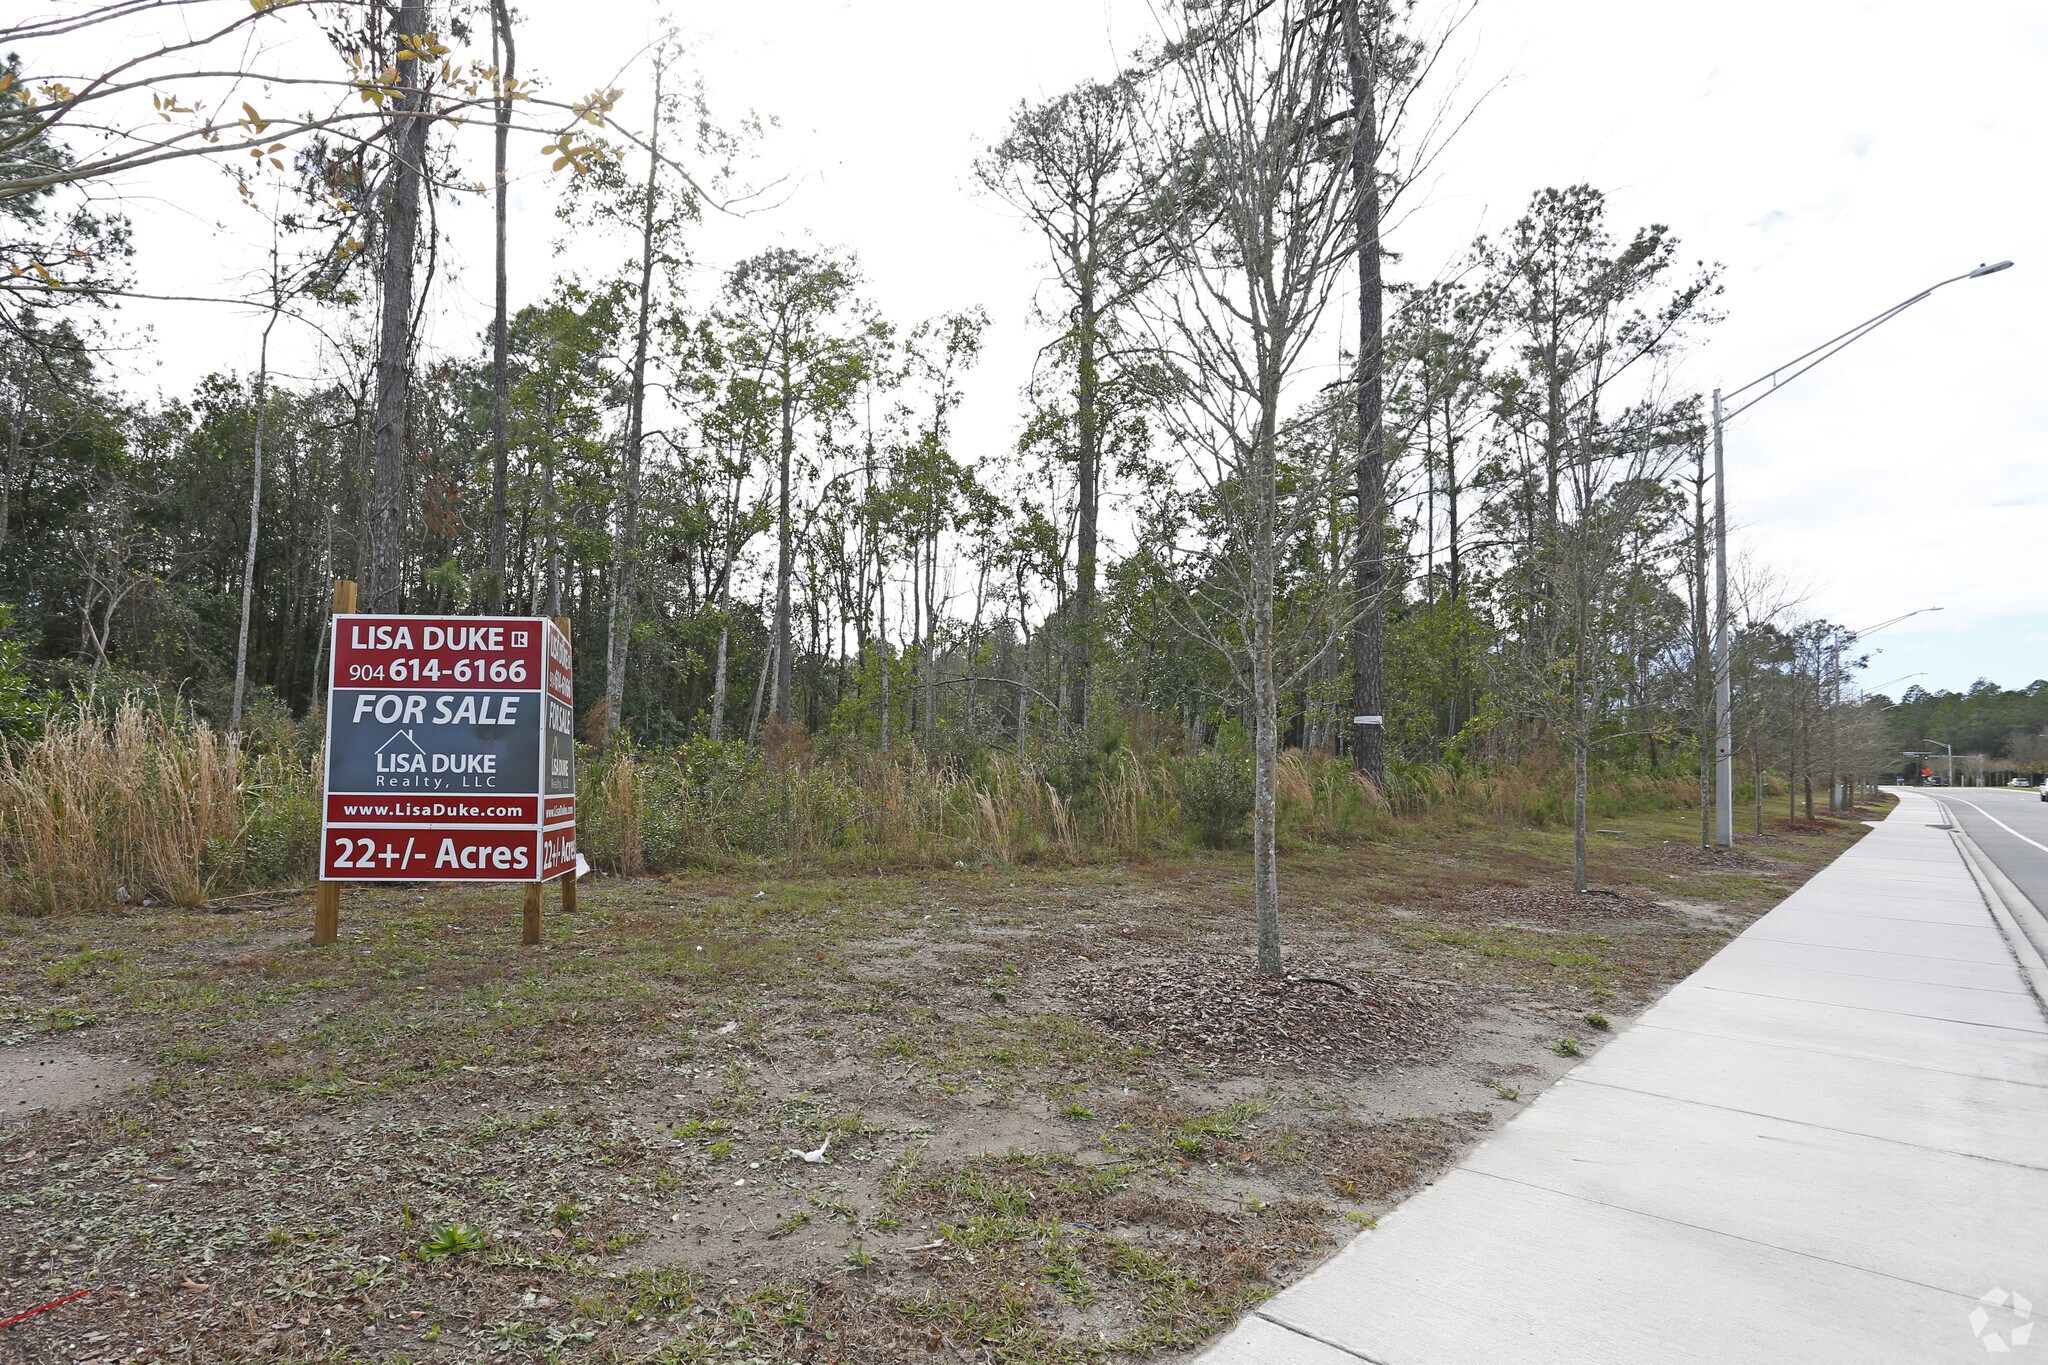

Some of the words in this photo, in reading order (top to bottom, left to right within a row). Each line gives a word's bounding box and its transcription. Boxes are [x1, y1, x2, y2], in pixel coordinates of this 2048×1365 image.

[351, 625, 414, 650] LISA
[423, 626, 504, 651] DUKE
[349, 664, 385, 681] 904
[389, 658, 527, 683] 614-6166
[353, 694, 427, 724] FOR
[432, 695, 520, 725] SALE
[549, 702, 559, 731] FOR
[558, 706, 571, 735] SALE
[376, 753, 427, 773] LISA
[432, 754, 497, 774] DUKE
[551, 757, 559, 776] LISA
[558, 758, 569, 777] DUKE
[376, 775, 449, 790] Realty,
[462, 776, 496, 788] LLC
[343, 802, 523, 817] www.LisaDuke.com
[333, 837, 427, 870] 22+/-
[434, 838, 529, 870] Acres
[543, 836, 561, 870] 22+/-
